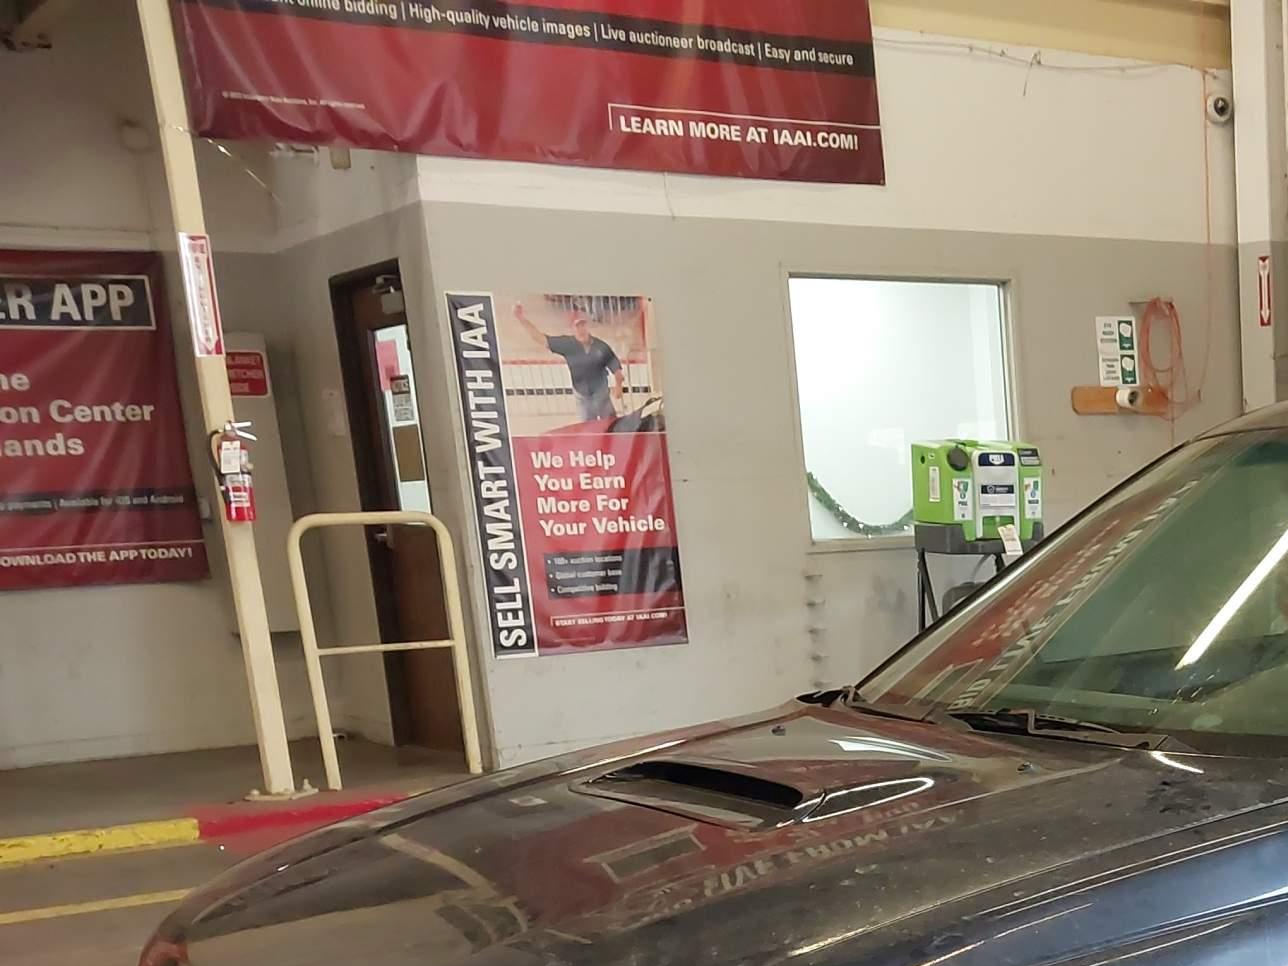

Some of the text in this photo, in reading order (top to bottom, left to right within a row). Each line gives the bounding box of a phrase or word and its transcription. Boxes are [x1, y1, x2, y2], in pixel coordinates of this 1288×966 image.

[345, 0, 398, 19] bidding
[409, 6, 489, 26] High-quality
[492, 14, 539, 32] vehicle
[542, 18, 591, 39] images
[601, 24, 626, 42] Live
[629, 28, 694, 49] auctioneer
[697, 36, 755, 56] broadcast
[764, 43, 791, 63] Easy
[794, 48, 816, 62] and
[818, 50, 854, 66] secure
[619, 115, 859, 150] LEARN MORE AT IAAI.COM!
[0, 283, 134, 321] R APP
[49, 399, 155, 424] Center
[0, 433, 85, 457] ands
[530, 450, 616, 470] We Help
[457, 303, 528, 647] SELL SMART WITH IAA
[534, 472, 625, 492] You Earn
[537, 494, 629, 514] More For
[539, 514, 665, 537] Your Vehicle
[0, 547, 192, 568] OWNLOAD THE APP TODAY!
